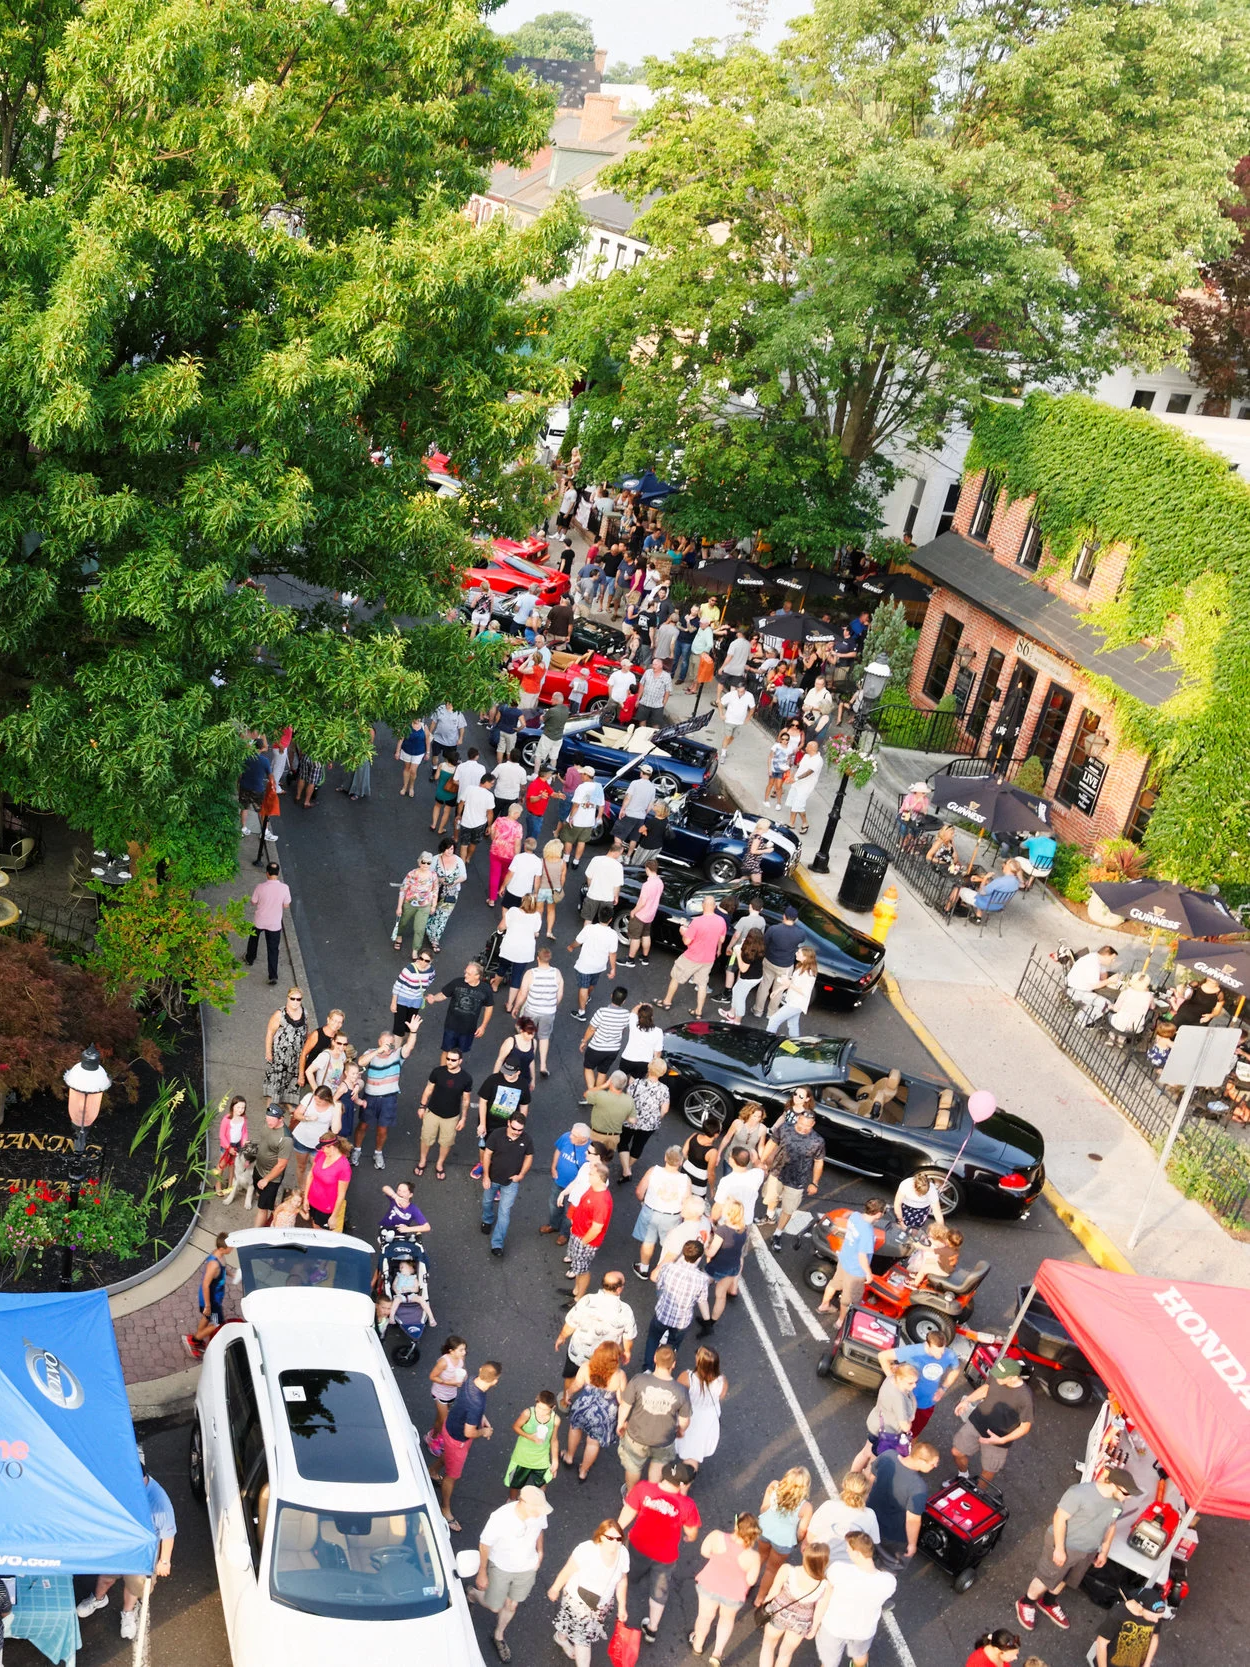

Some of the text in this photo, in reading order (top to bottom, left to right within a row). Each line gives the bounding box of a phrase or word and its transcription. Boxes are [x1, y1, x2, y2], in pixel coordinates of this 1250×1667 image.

[1016, 637, 1030, 656] 86
[1082, 770, 1098, 789] LIVE
[947, 801, 986, 823] GUINNESS
[1130, 908, 1182, 930] GUINNESS
[1193, 962, 1244, 988] GUINNESS
